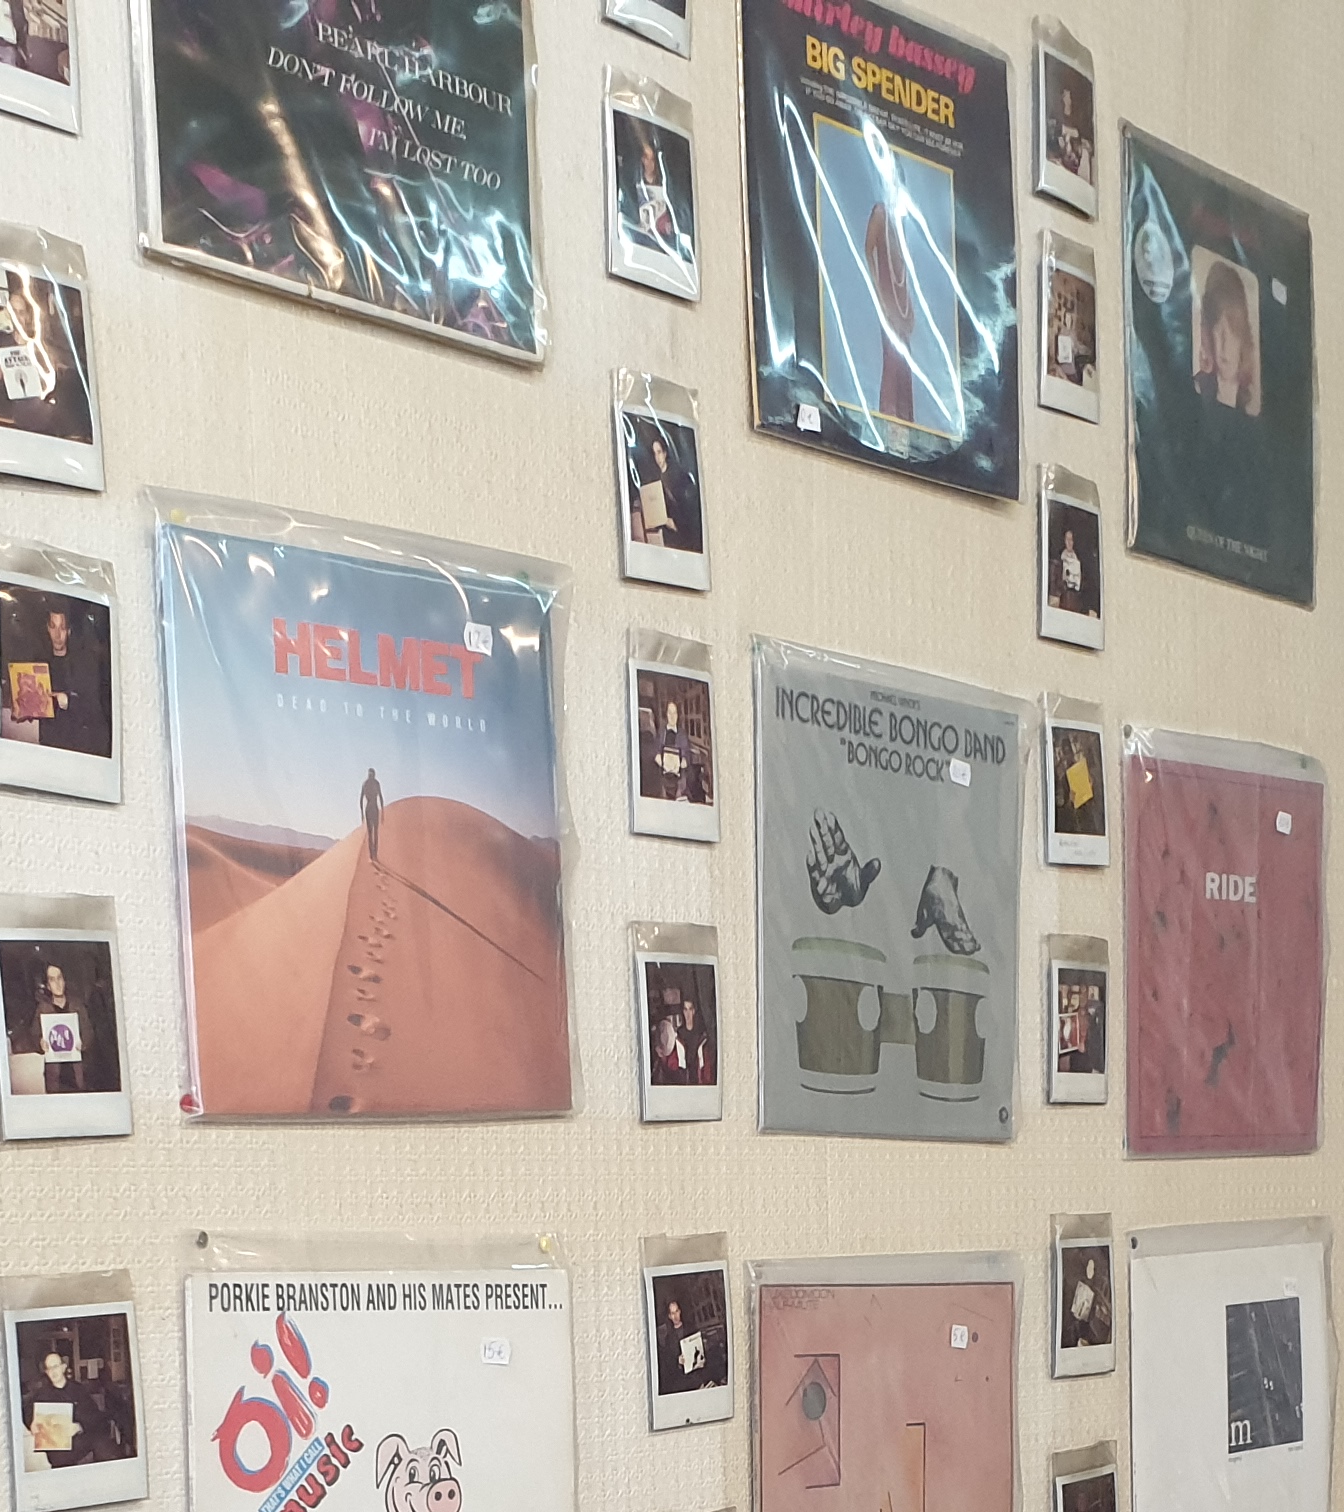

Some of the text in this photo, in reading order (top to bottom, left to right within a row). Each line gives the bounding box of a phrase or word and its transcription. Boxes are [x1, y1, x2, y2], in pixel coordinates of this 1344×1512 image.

[268, 47, 335, 87] DON'T
[340, 73, 429, 122] FOLLOW
[806, 34, 846, 82] BIG
[851, 56, 955, 128] SPENDER
[403, 143, 456, 174] LOST
[461, 161, 501, 190] TOO
[272, 617, 483, 699] HELMET
[344, 699, 363, 718] TO
[379, 706, 412, 725] THE
[426, 712, 488, 733] WORLD
[775, 686, 883, 740] INCREDIBLE
[889, 712, 959, 754] BONGO
[964, 729, 1006, 765] BAND
[1205, 872, 1257, 903] RIDE
[209, 1282, 271, 1313] PORKIE
[275, 1282, 362, 1312] BRANSTON
[366, 1282, 397, 1311] AND
[402, 1283, 427, 1311] HIS
[431, 1283, 481, 1311] MATES
[1230, 1419, 1252, 1446] m
[282, 1457, 308, 1493] WHAT
